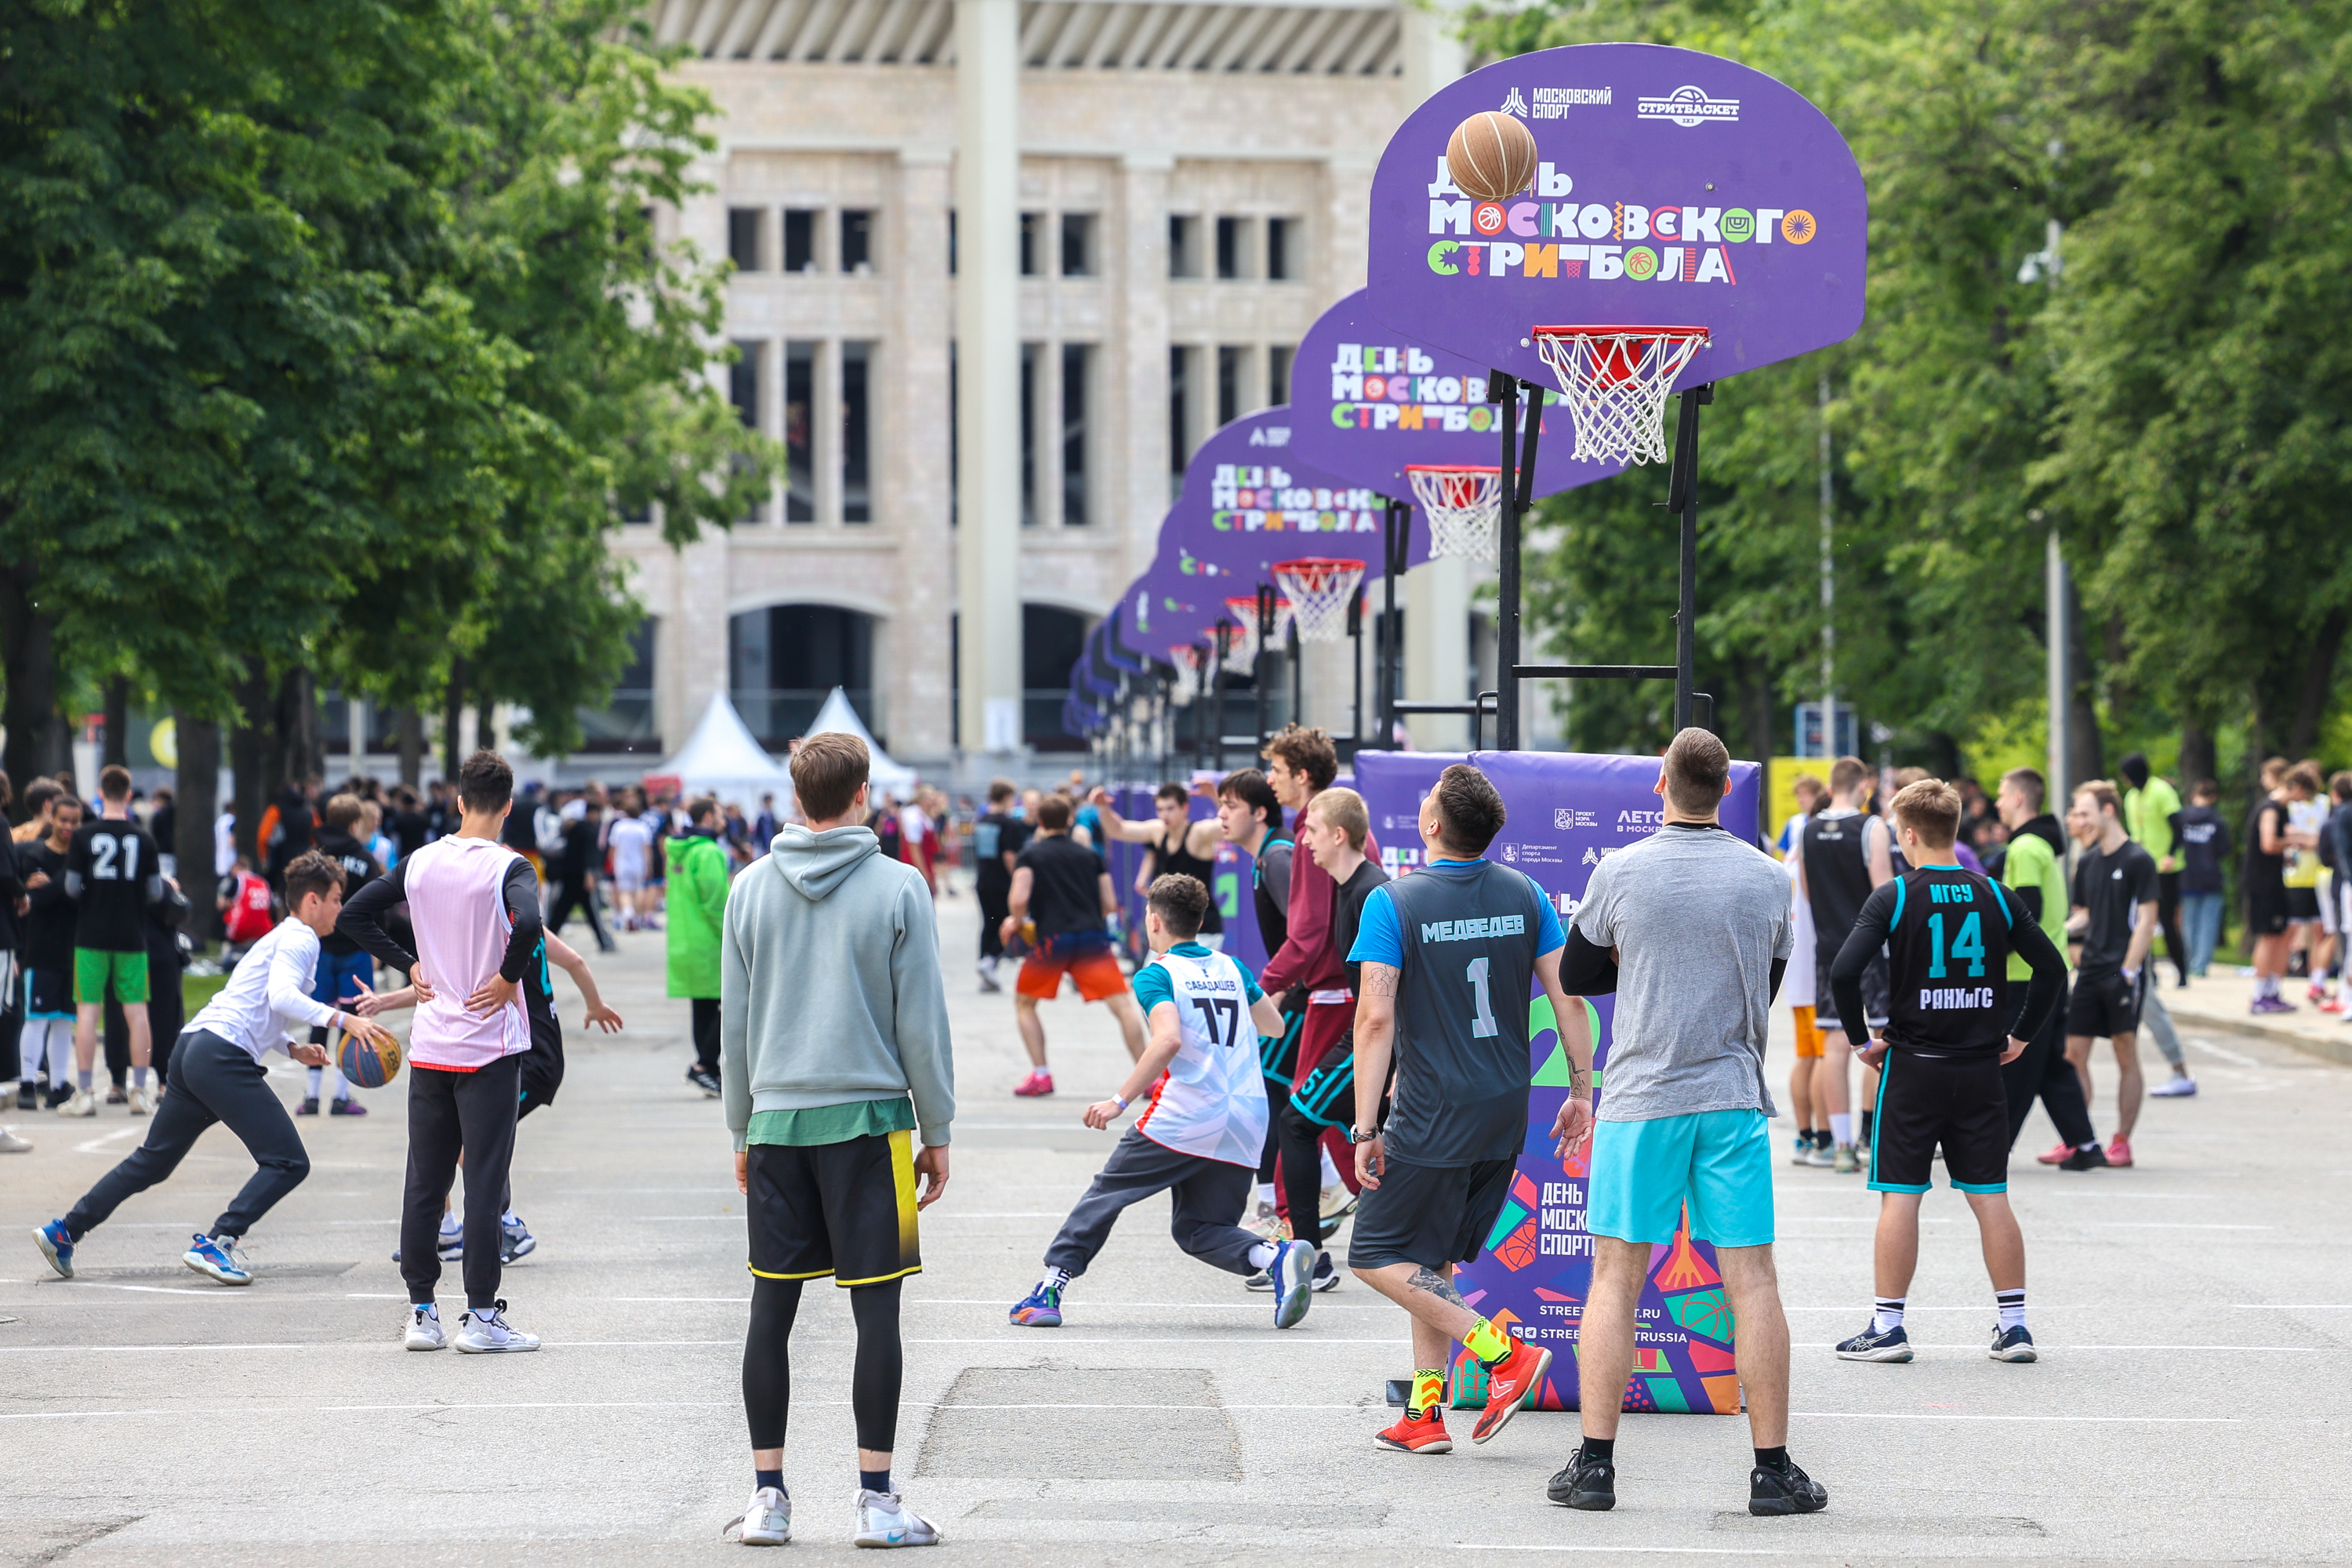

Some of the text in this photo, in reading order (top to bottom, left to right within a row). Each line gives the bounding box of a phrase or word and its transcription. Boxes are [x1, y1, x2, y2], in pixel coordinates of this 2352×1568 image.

[1533, 87, 1612, 105] МОСКОВСКИЙ
[1638, 103, 1740, 116] СТРИТБАСКЕТ
[1533, 104, 1570, 119] СПОРТ
[1428, 155, 1573, 199] ДЬ
[1428, 199, 1817, 245] МОСКОВСКОГО
[1428, 240, 1736, 285] СТРИТБОЛА
[1331, 343, 1434, 374] ДЕНЬ
[1211, 463, 1292, 488] ДЕНЬ
[1212, 510, 1378, 532] СТРИТБОЛА
[91, 833, 140, 881] 21
[1929, 884, 1974, 903] ИГСУ
[1421, 914, 1525, 943] МЕДВЕДЕВ
[1927, 911, 1985, 978] 14
[1185, 980, 1236, 992] САБАДАШЕВ
[1466, 956, 1499, 1039] 1
[1920, 987, 1994, 1010] РАНХиГС
[1191, 997, 1239, 1048] 17
[1541, 1182, 1583, 1206] ДЕНЬ
